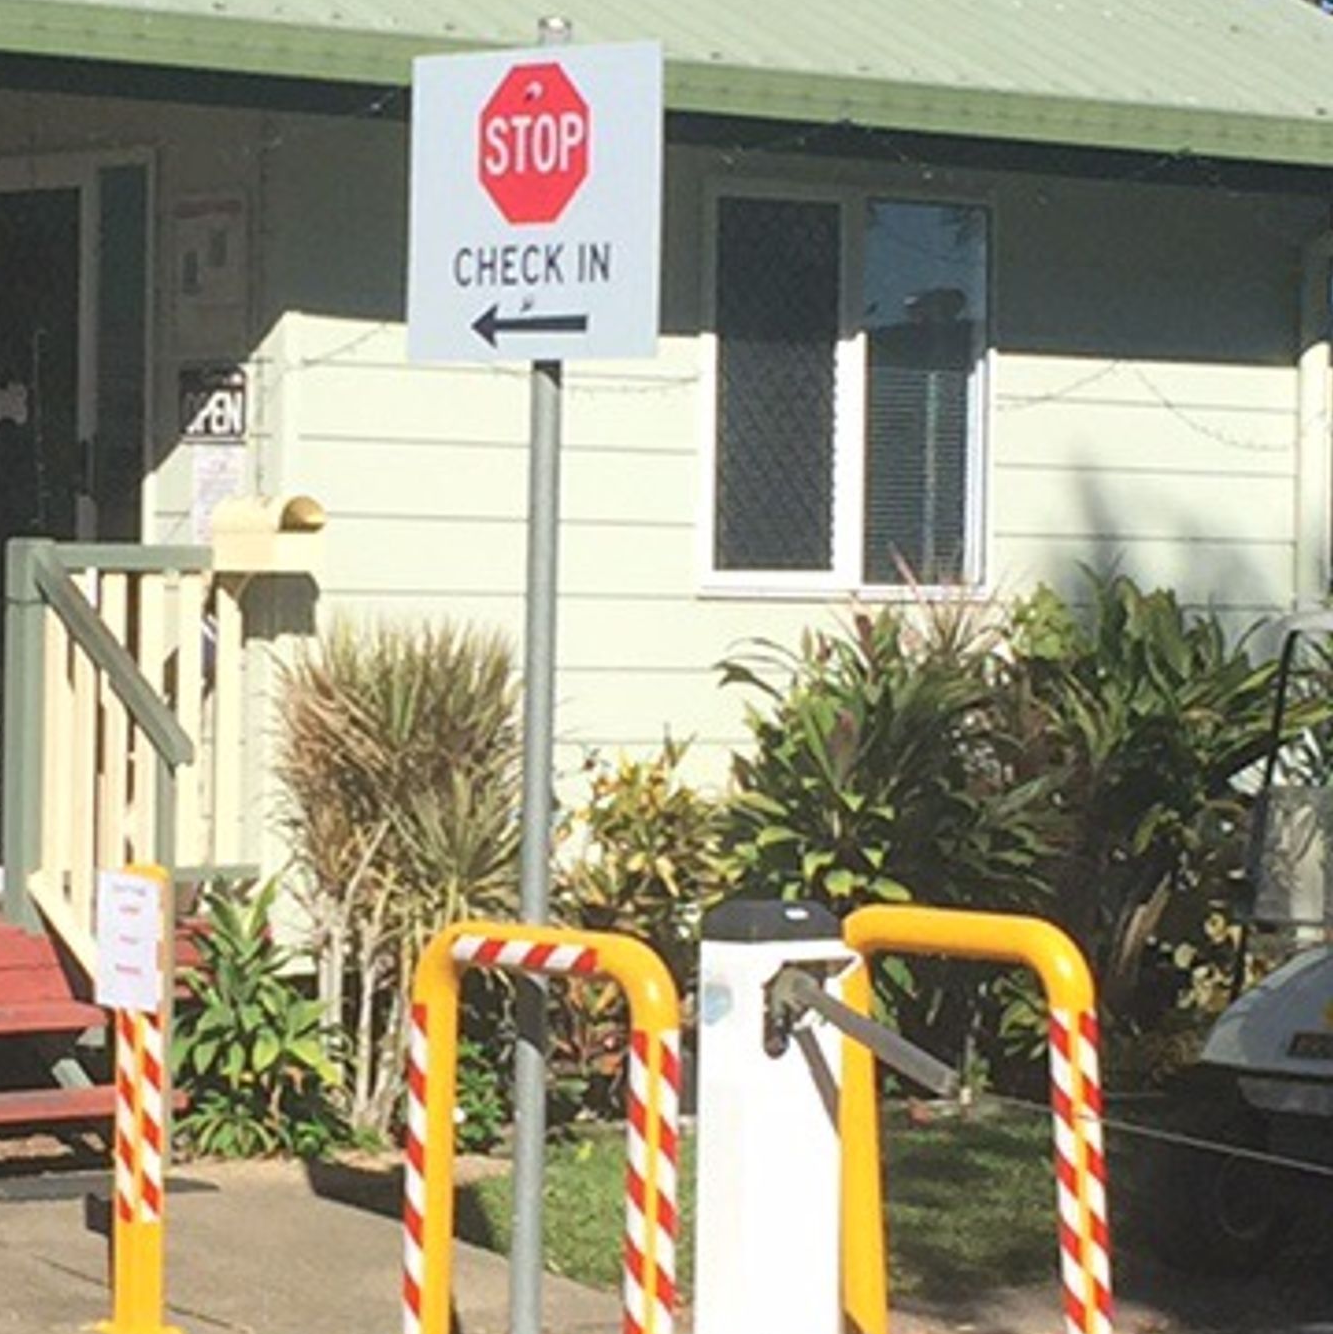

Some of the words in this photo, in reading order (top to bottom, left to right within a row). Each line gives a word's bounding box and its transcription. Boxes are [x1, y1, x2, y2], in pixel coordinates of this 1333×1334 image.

[485, 112, 584, 176] STOP
[453, 244, 565, 287] CHECK
[577, 243, 612, 283] IN
